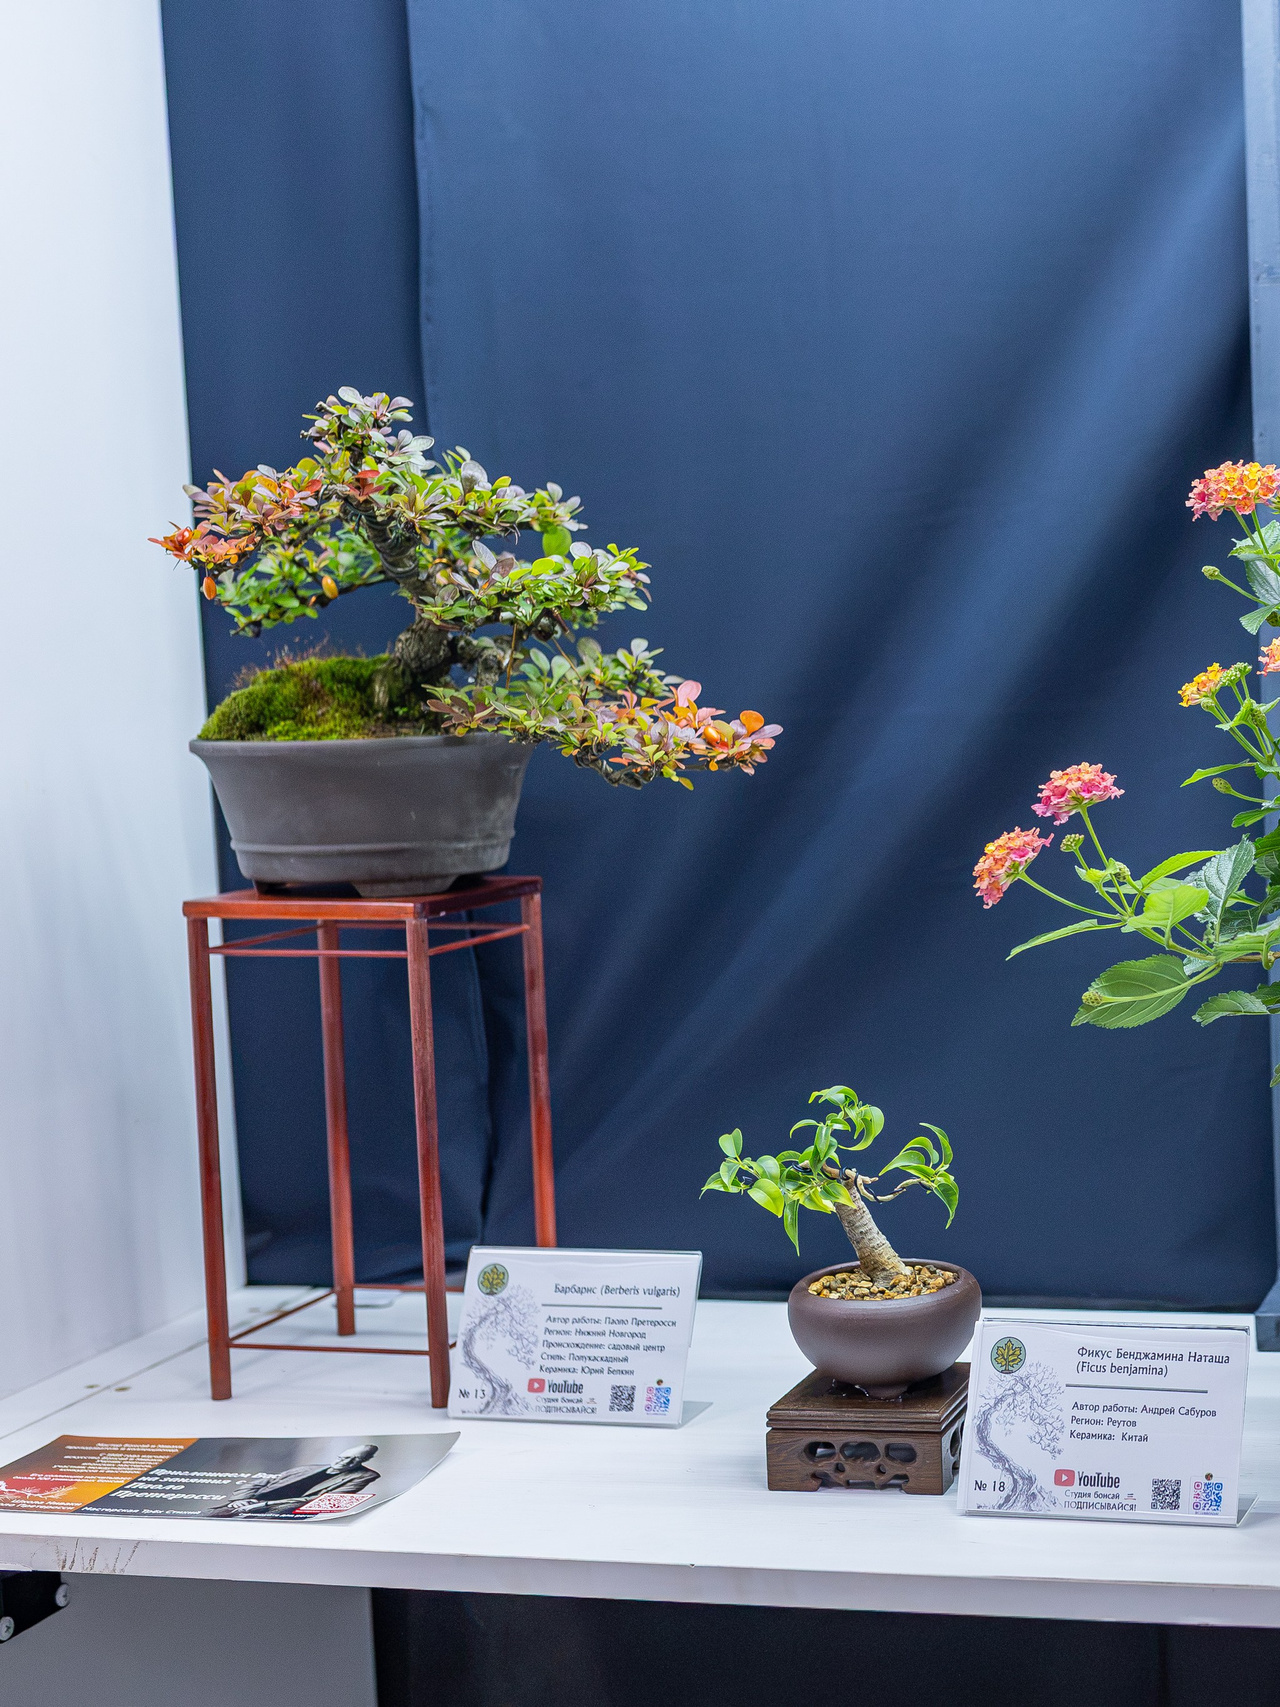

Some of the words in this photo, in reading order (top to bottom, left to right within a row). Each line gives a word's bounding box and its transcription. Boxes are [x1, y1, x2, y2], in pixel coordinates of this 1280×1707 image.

[554, 1284, 597, 1295] Барбарис
[601, 1284, 639, 1296] (Berberis
[643, 1286, 680, 1297] vulgaris)
[546, 1316, 570, 1325] Автор
[572, 1316, 601, 1325] работы:
[544, 1328, 572, 1337] Регион:
[575, 1329, 606, 1338] Нижний
[608, 1330, 646, 1339] Новгород
[608, 1343, 640, 1351] садовый
[643, 1344, 665, 1352] центр
[541, 1353, 566, 1361] Стиль:
[1077, 1347, 1112, 1359] Фикус
[1116, 1349, 1183, 1362] Бенджамина
[1188, 1352, 1230, 1364] Наташа
[540, 1365, 578, 1375] Керамика:
[581, 1366, 604, 1375] Юрий
[1077, 1362, 1106, 1375] (Ficus
[1110, 1364, 1168, 1377] benjamina)
[548, 1380, 583, 1394] YouTube
[474, 1390, 486, 1399] 13
[1072, 1402, 1099, 1413] Автор
[1102, 1403, 1137, 1414] работы:
[1141, 1405, 1175, 1416] Андрей
[1178, 1407, 1216, 1418] Сабуров
[1071, 1416, 1104, 1428] Регион:
[1107, 1417, 1136, 1428] Реутов
[1070, 1430, 1115, 1443] Керамика:
[1121, 1433, 1148, 1442] Китай
[974, 1480, 987, 1492] №
[992, 1481, 1005, 1492] 18
[1078, 1472, 1120, 1488] YouTube
[1065, 1489, 1091, 1500] Студия
[1094, 1490, 1120, 1500] бонсай
[1064, 1501, 1136, 1512] ПОДПИСЫВАЙСЯ!
